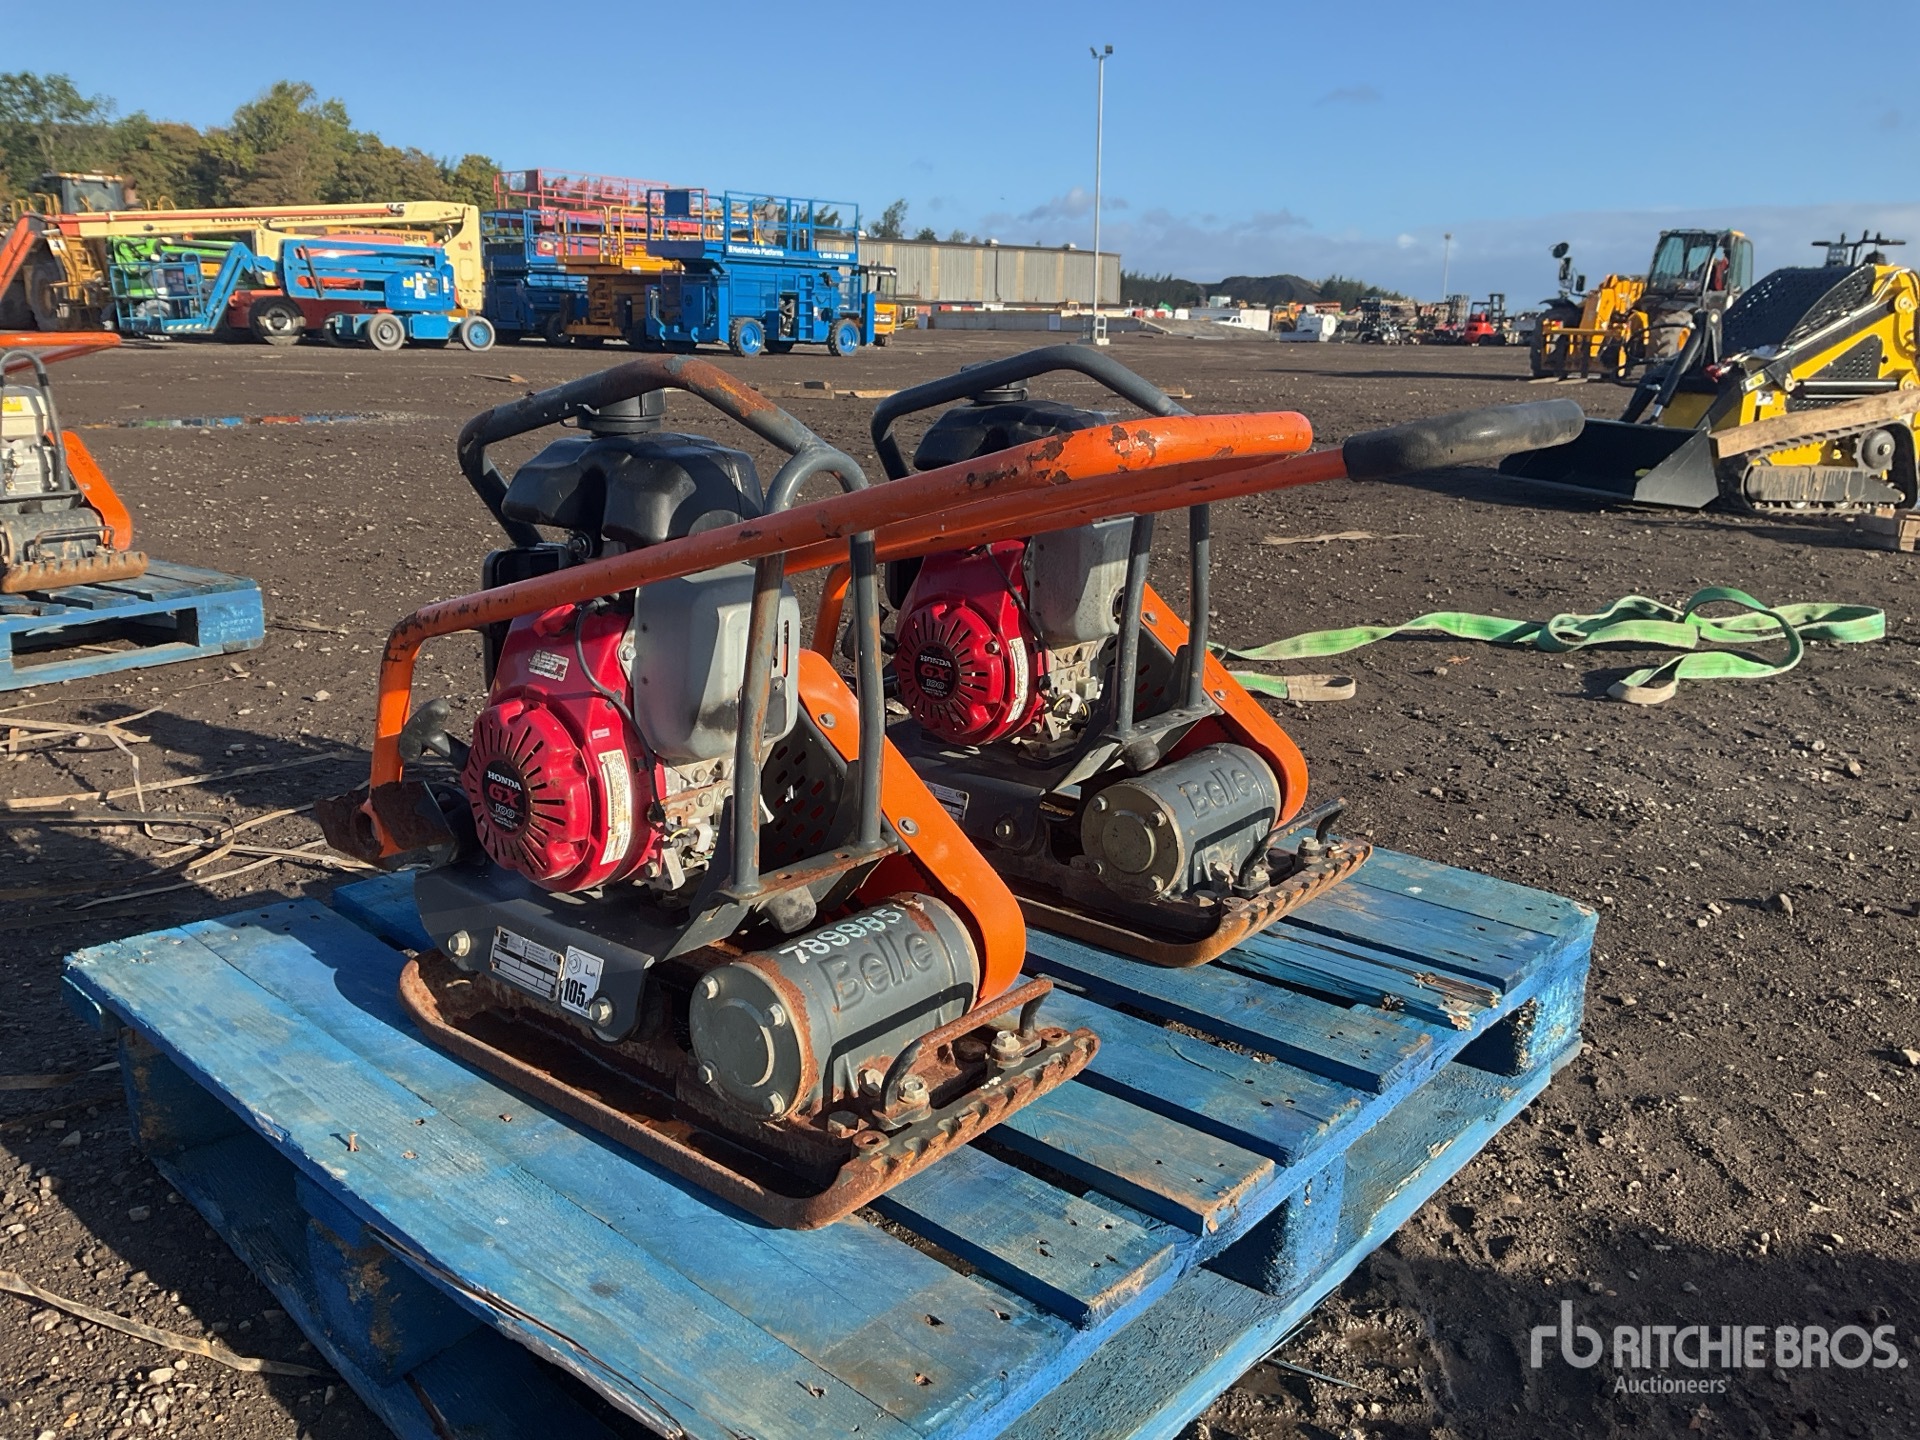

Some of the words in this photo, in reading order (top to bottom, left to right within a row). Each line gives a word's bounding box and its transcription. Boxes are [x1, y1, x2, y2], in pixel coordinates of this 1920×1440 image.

[733, 246, 760, 255] Nationwide
[761, 247, 784, 257] Platforms
[920, 654, 952, 668] HONDA
[920, 664, 951, 681] GX
[926, 679, 945, 690] 100
[487, 770, 522, 791] HONDA
[488, 783, 520, 809] GX
[1176, 767, 1251, 820] Belle
[495, 803, 515, 819] 100
[816, 930, 934, 1012] Belle
[563, 977, 588, 1008] 105
